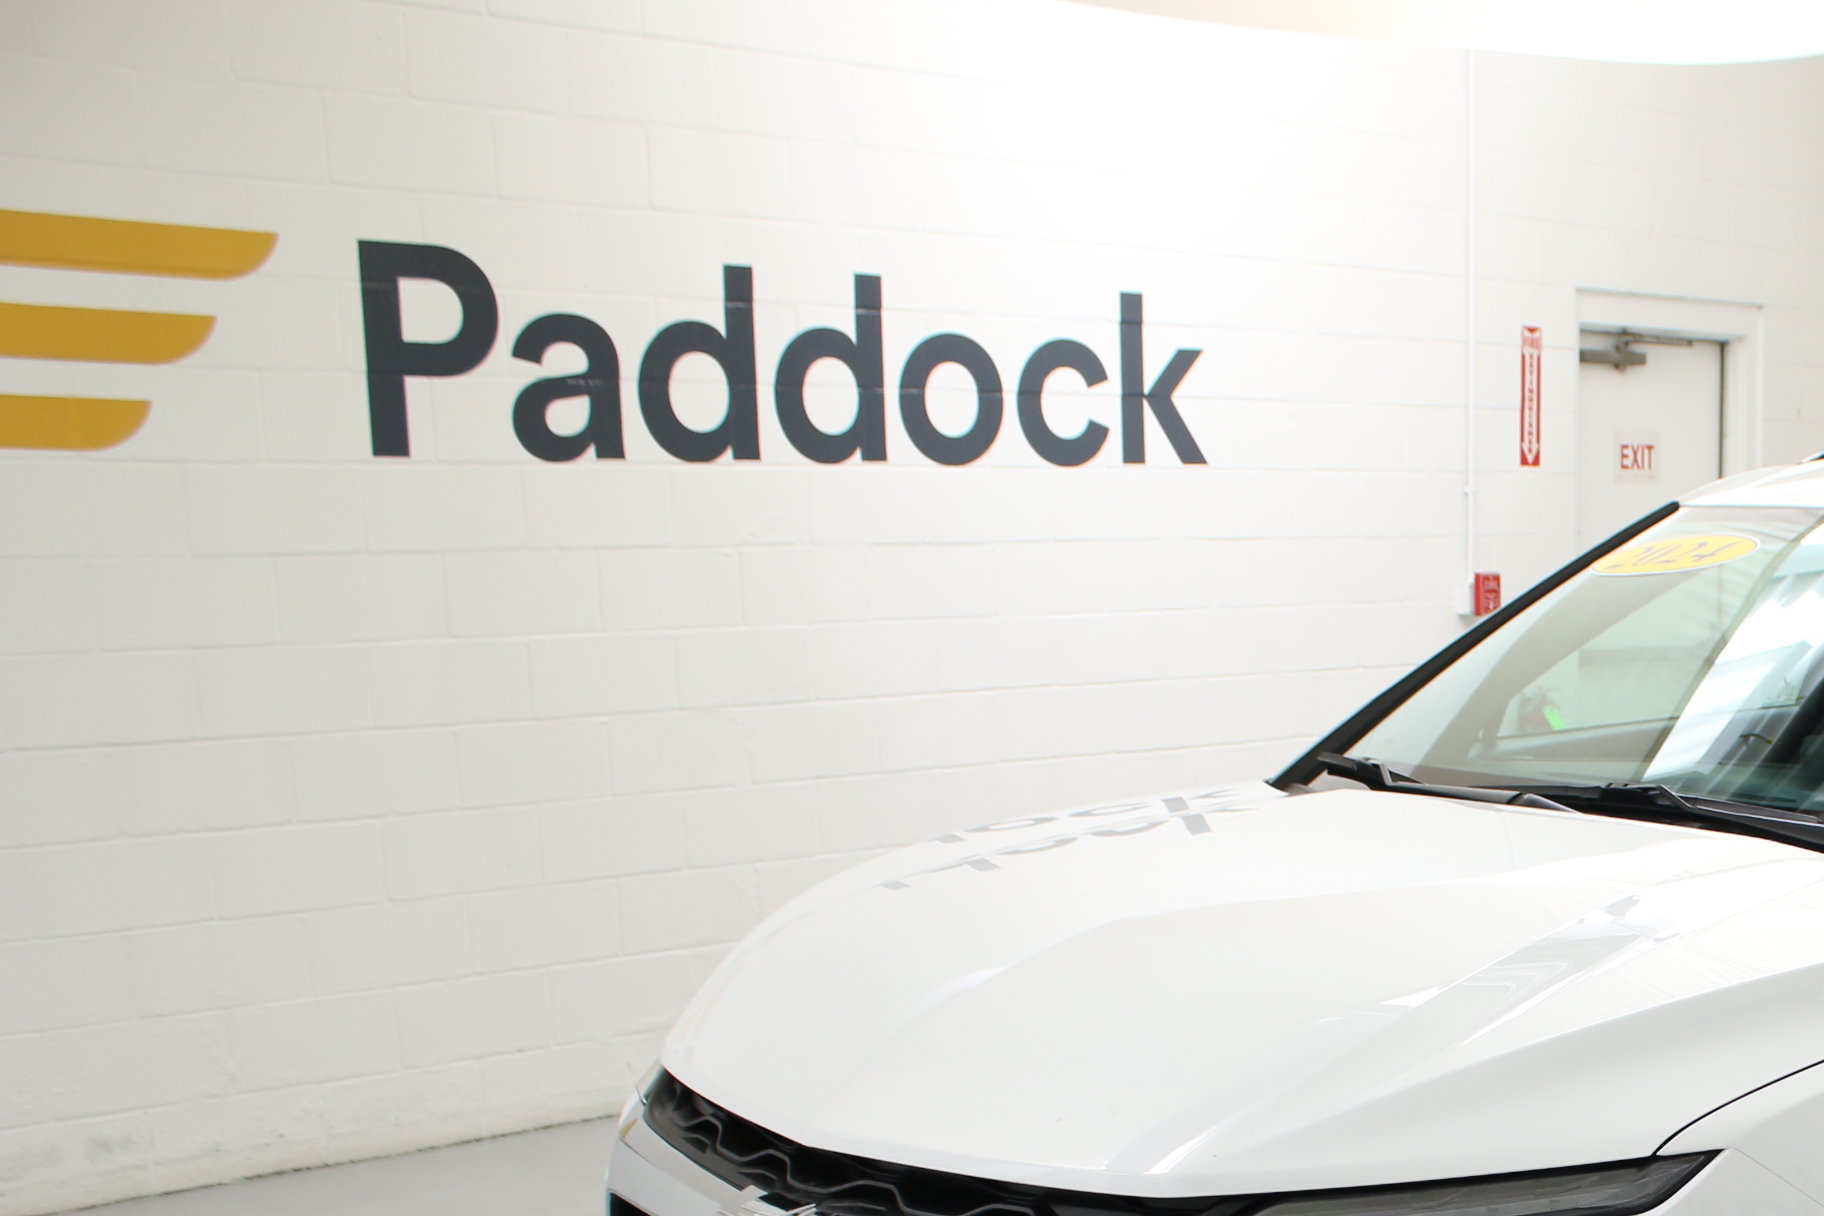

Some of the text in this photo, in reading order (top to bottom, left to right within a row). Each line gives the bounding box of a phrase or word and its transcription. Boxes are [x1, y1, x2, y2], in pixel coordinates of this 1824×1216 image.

[357, 239, 1209, 467] Paddock
[1620, 443, 1656, 470] EXIT
[1603, 540, 1745, 569] 2024
